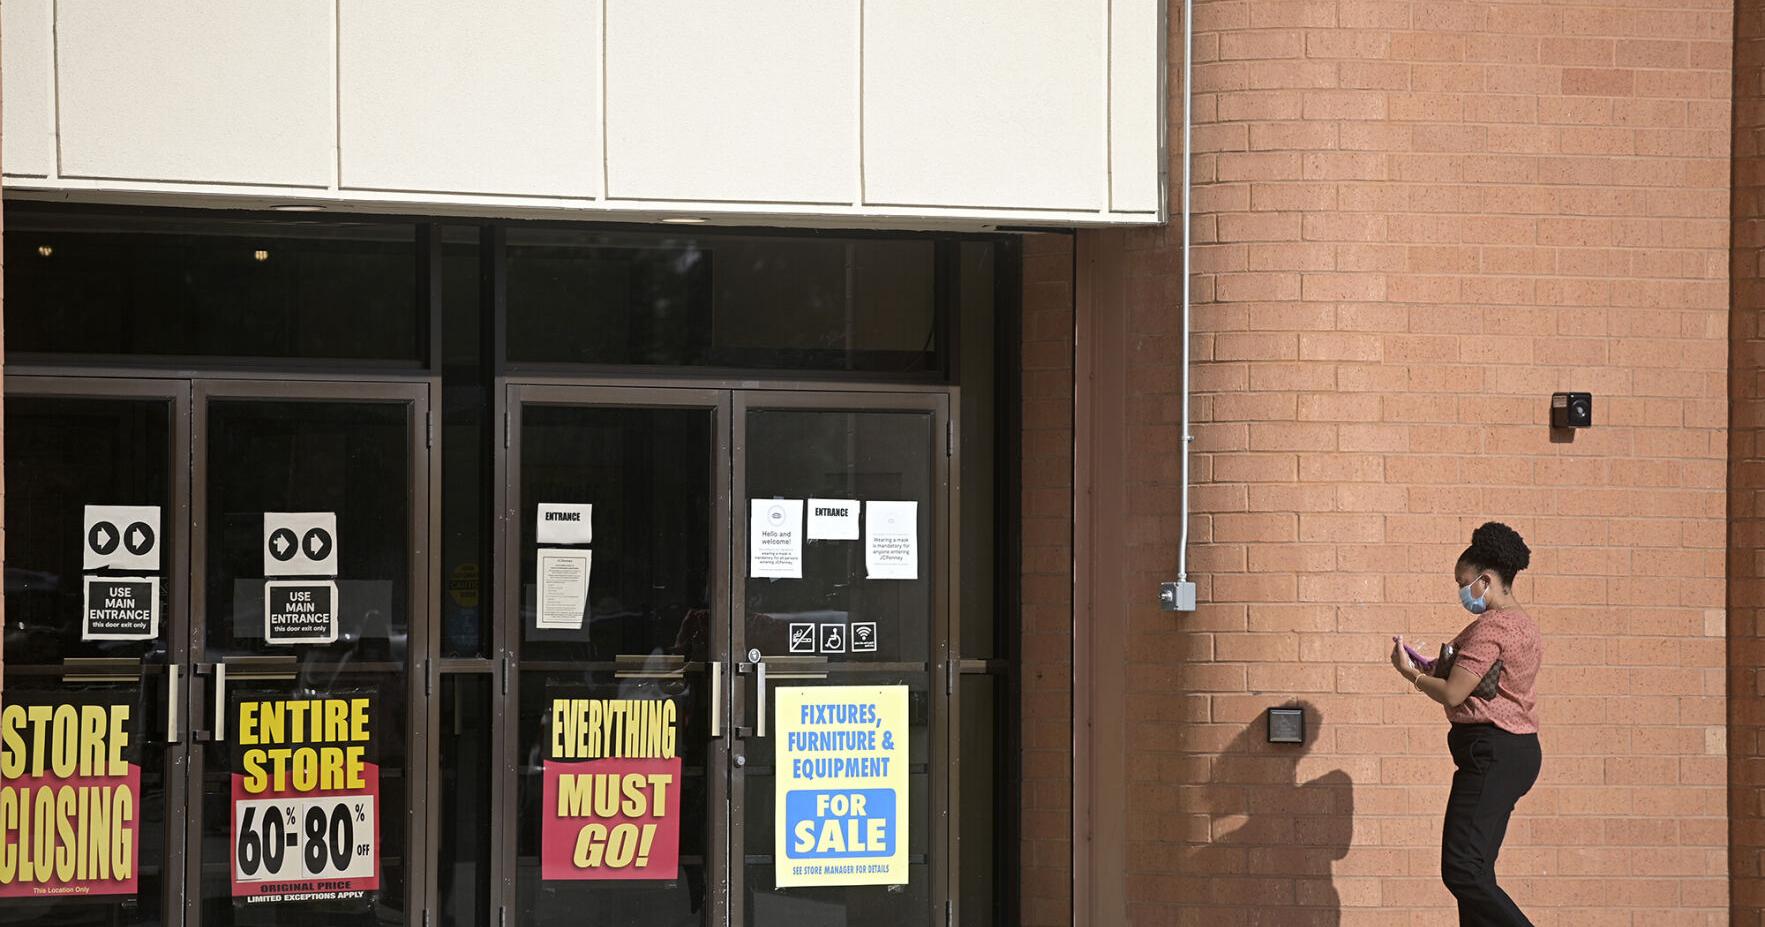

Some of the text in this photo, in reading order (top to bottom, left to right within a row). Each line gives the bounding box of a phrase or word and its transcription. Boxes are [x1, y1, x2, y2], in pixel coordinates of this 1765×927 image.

[545, 511, 581, 522] ENTRANCE
[815, 507, 849, 517] ENTRANCE
[761, 530, 792, 538] Hello and
[109, 587, 132, 598] USE
[289, 591, 312, 602] USE
[105, 598, 136, 609] MAIN
[285, 602, 315, 613] MAIN
[89, 609, 150, 620] ENTRANCE
[271, 613, 330, 624] ENTRANCE
[133, 621, 147, 630] only
[313, 625, 327, 633] only
[239, 698, 370, 745] ENTIRE
[800, 704, 882, 728] FIXTURES,
[552, 699, 677, 759] EVERYTHING
[1, 704, 130, 780] STORE
[788, 730, 895, 752] FURNITURE &
[243, 746, 366, 794] STORE
[792, 757, 890, 781] EQUIPMENT
[557, 773, 673, 818] MUST
[816, 793, 867, 817] FOR
[0, 784, 133, 885] CLOSING
[794, 818, 887, 854] SALE
[357, 844, 370, 856] OFF
[573, 823, 657, 868] GO!
[793, 863, 890, 875] SEE STORE MANAGER FOR DETAILS
[75, 886, 90, 894] Only
[260, 881, 352, 893] ORIGINAL PRICE
[247, 890, 364, 903] LIMITED EXCEPTIONS APPLY
